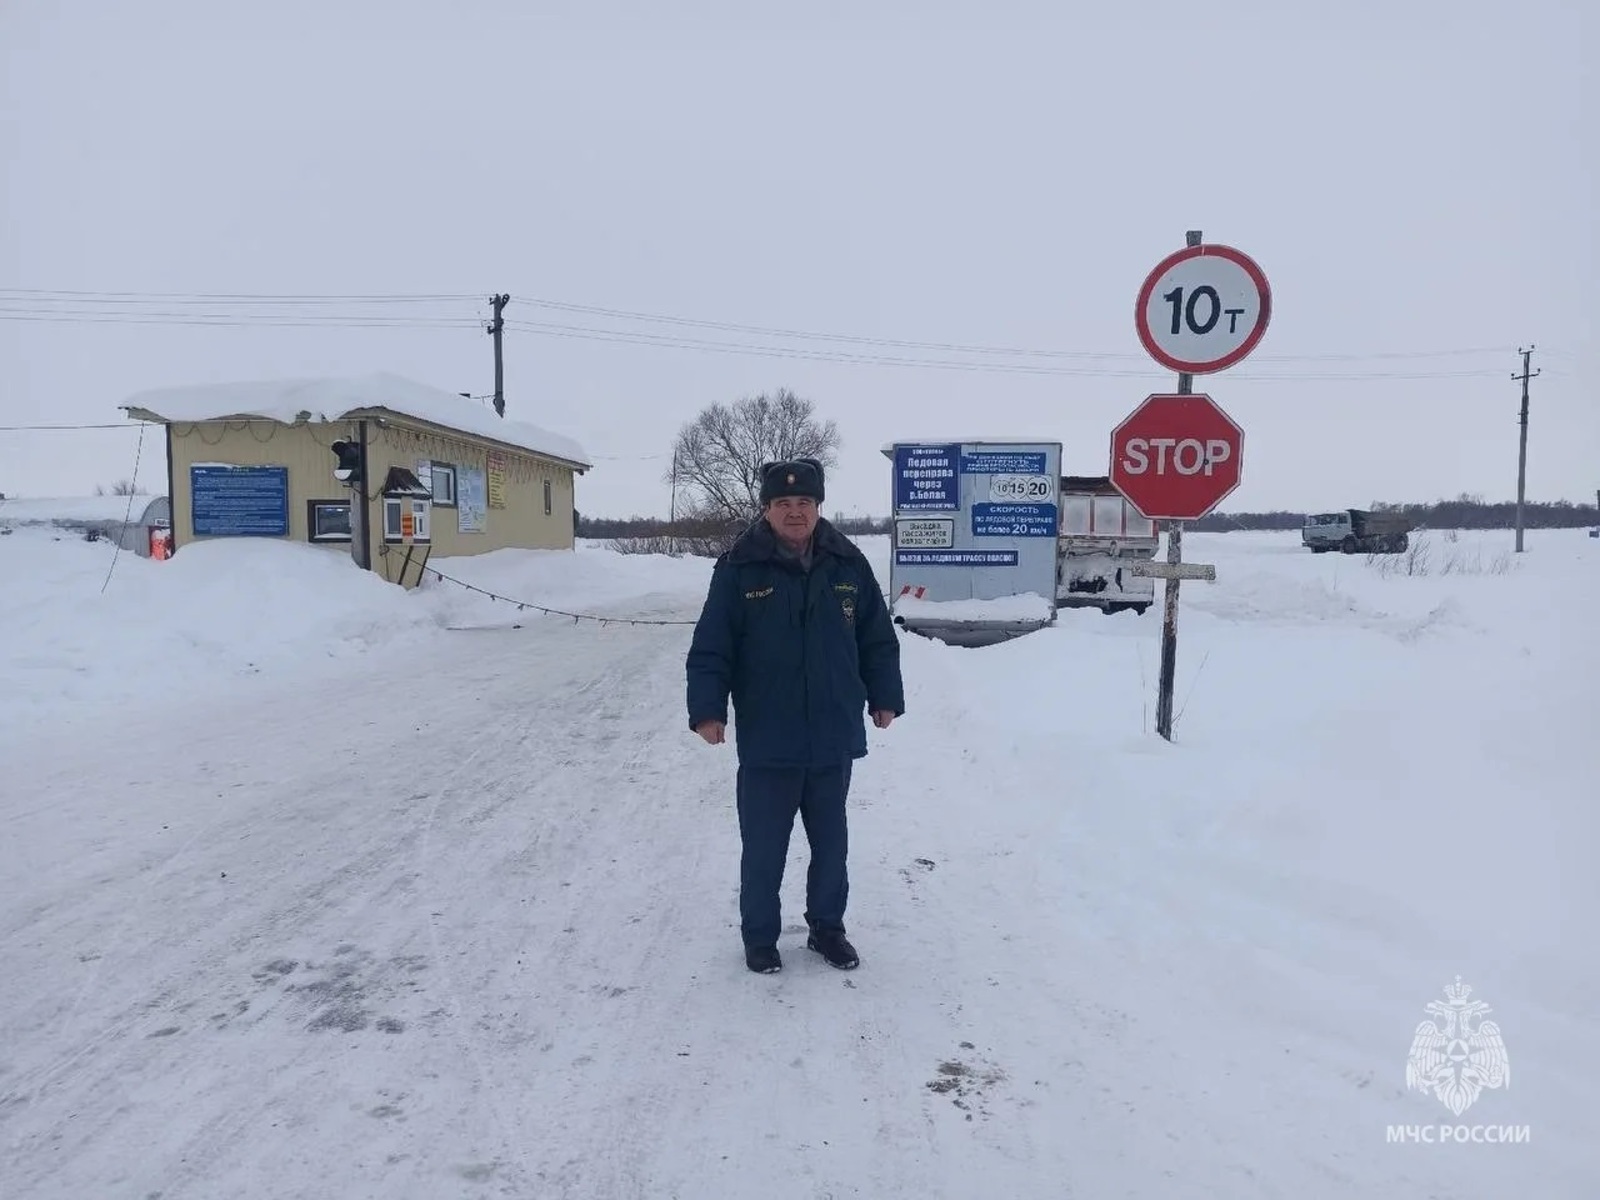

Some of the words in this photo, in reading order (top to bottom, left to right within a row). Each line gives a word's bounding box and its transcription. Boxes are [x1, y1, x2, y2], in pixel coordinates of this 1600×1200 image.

[1163, 285, 1221, 335] 10
[1123, 438, 1231, 476] STOP
[907, 457, 949, 468] Ледовая
[903, 469, 954, 479] переправа
[913, 480, 942, 490] через
[997, 484, 1008, 493] 10
[1010, 483, 1025, 494] 15
[1029, 482, 1047, 495] 20
[990, 506, 1040, 514] СКОРОСТЬ
[1012, 524, 1028, 534] 20
